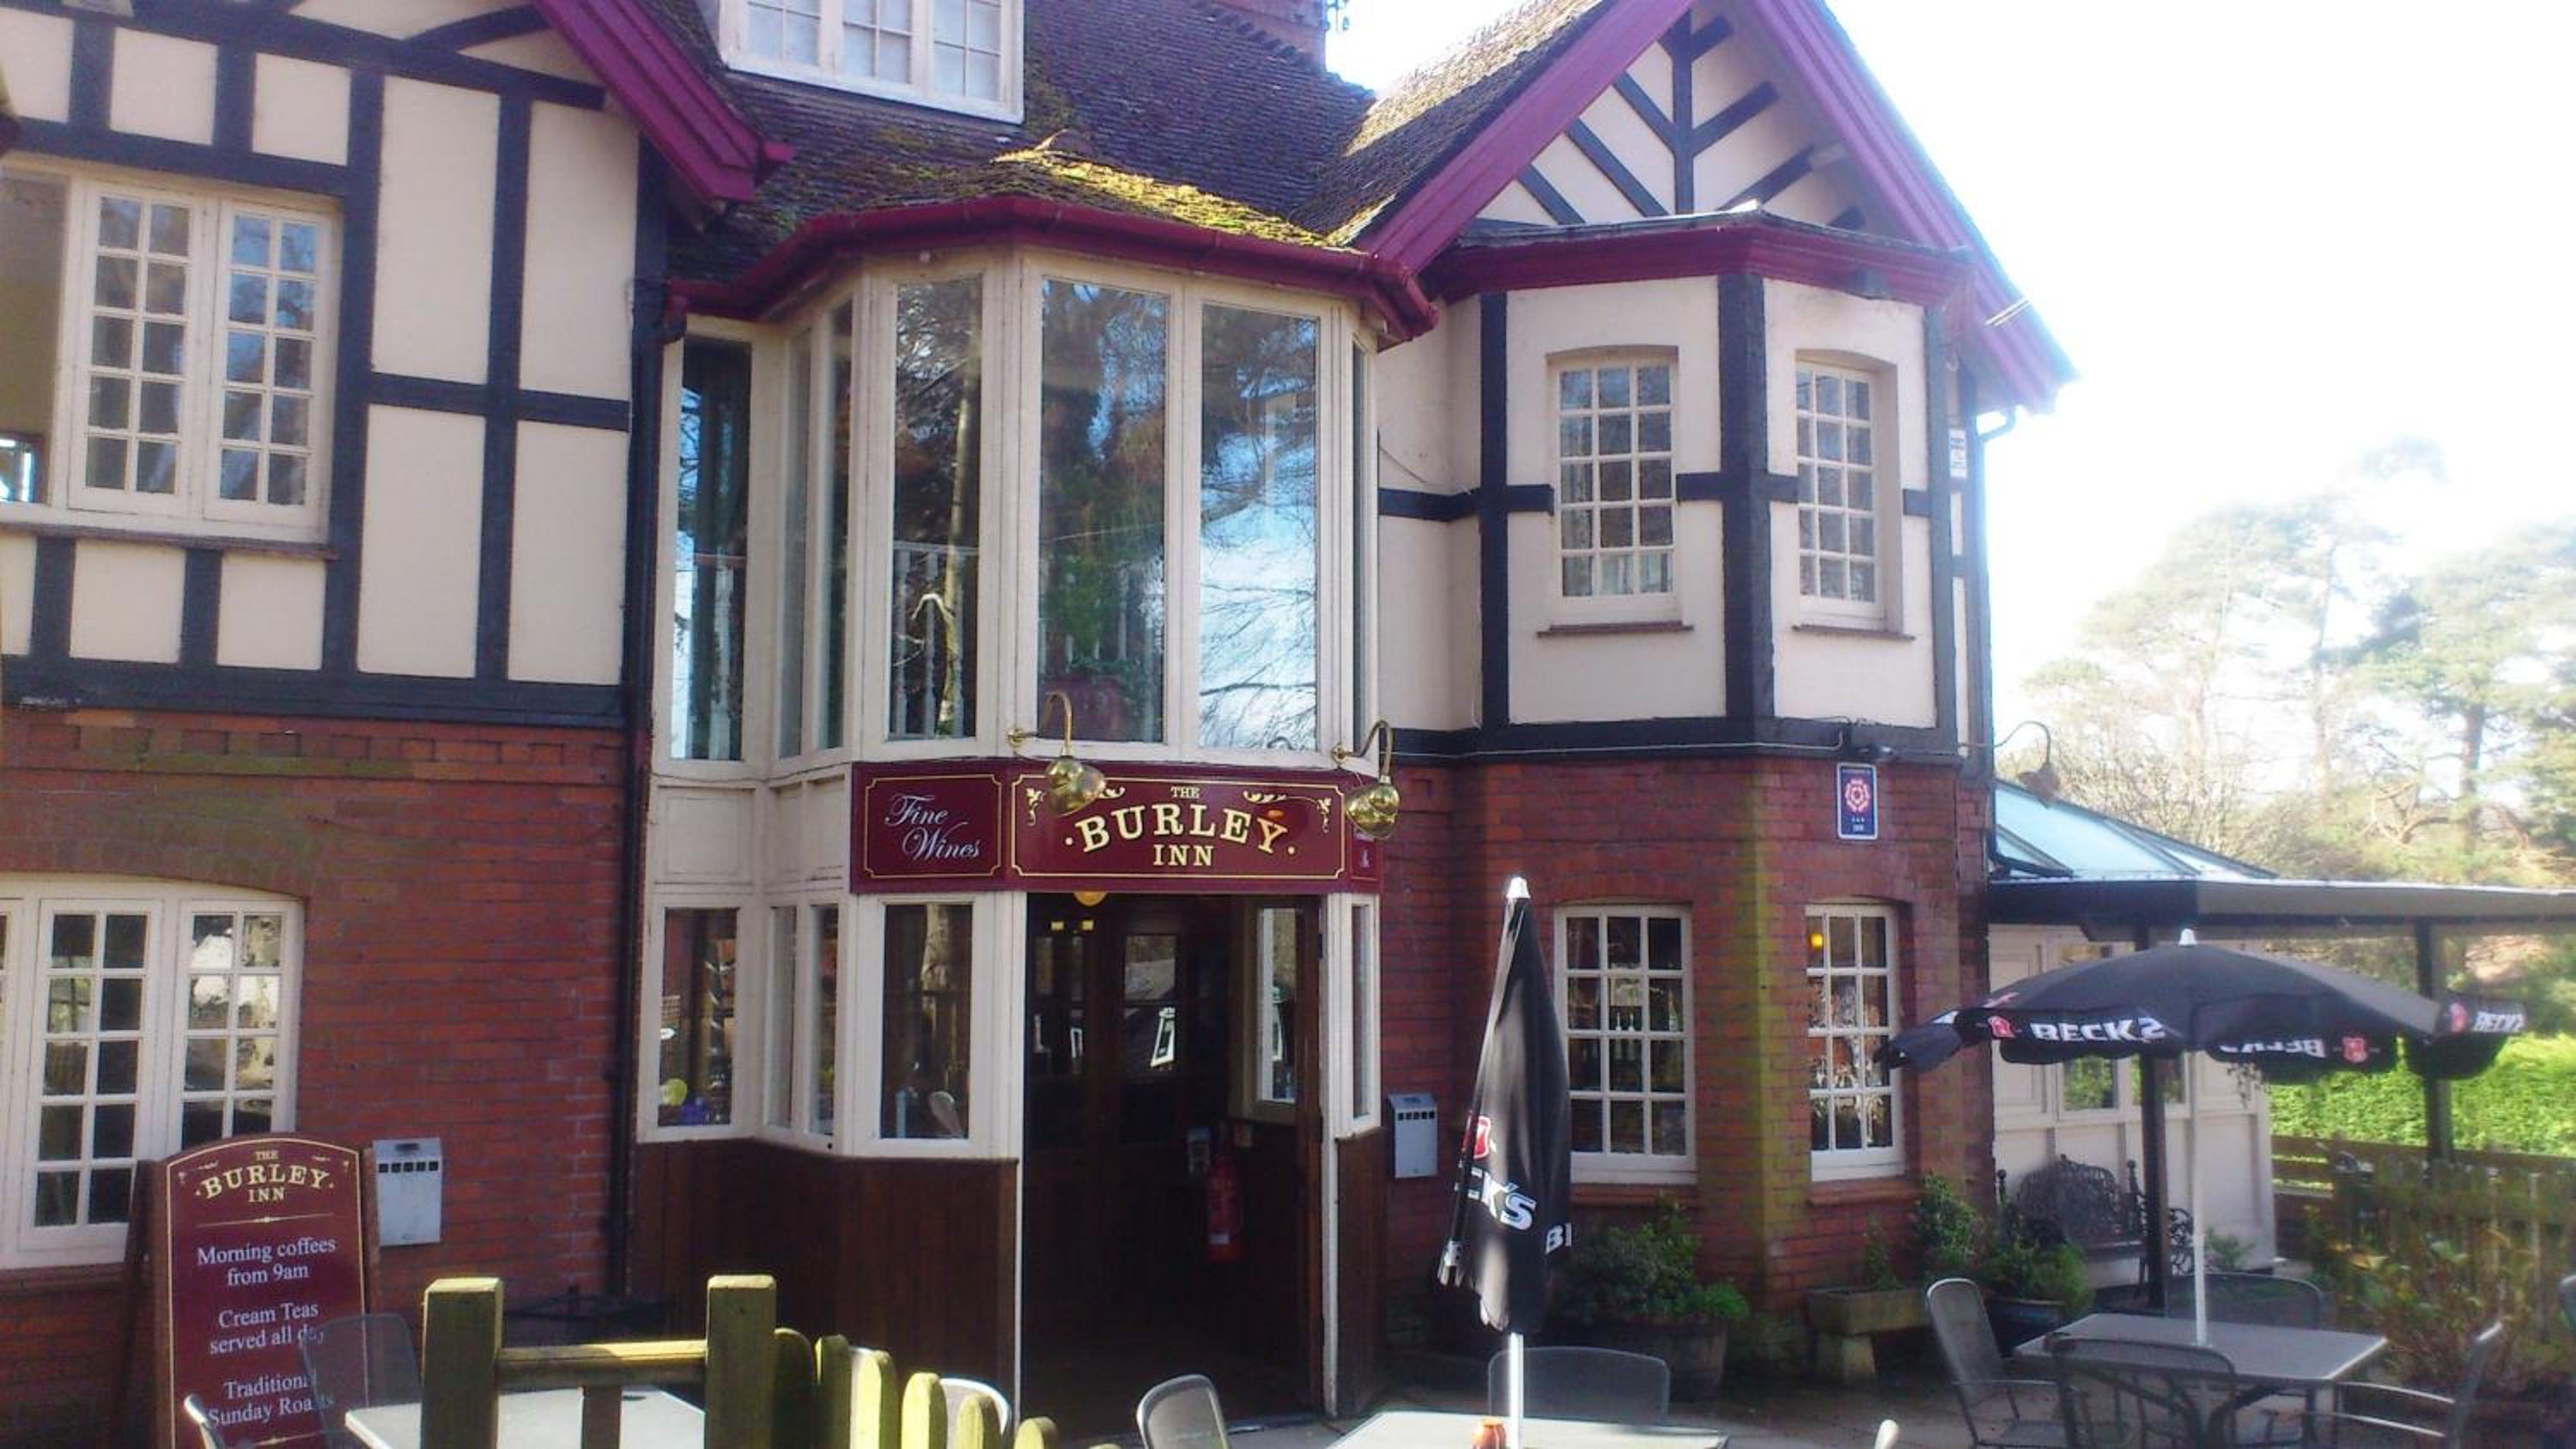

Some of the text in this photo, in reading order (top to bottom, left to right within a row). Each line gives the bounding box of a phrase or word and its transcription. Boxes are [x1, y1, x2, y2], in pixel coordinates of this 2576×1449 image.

[1170, 786, 1200, 799] THE
[884, 793, 948, 827] Fine
[902, 822, 981, 861] Wines
[1075, 803, 1287, 853] BURLEY
[1153, 845, 1213, 866] INN
[201, 1163, 330, 1199] BURLEY
[248, 1188, 285, 1203] INN
[197, 1237, 337, 1265] Morning coffees
[228, 1264, 309, 1286] from 9am
[219, 1302, 319, 1328] Cream Teas
[210, 1330, 265, 1355] served
[271, 1326, 291, 1345] all
[209, 1403, 272, 1428] Sunday
